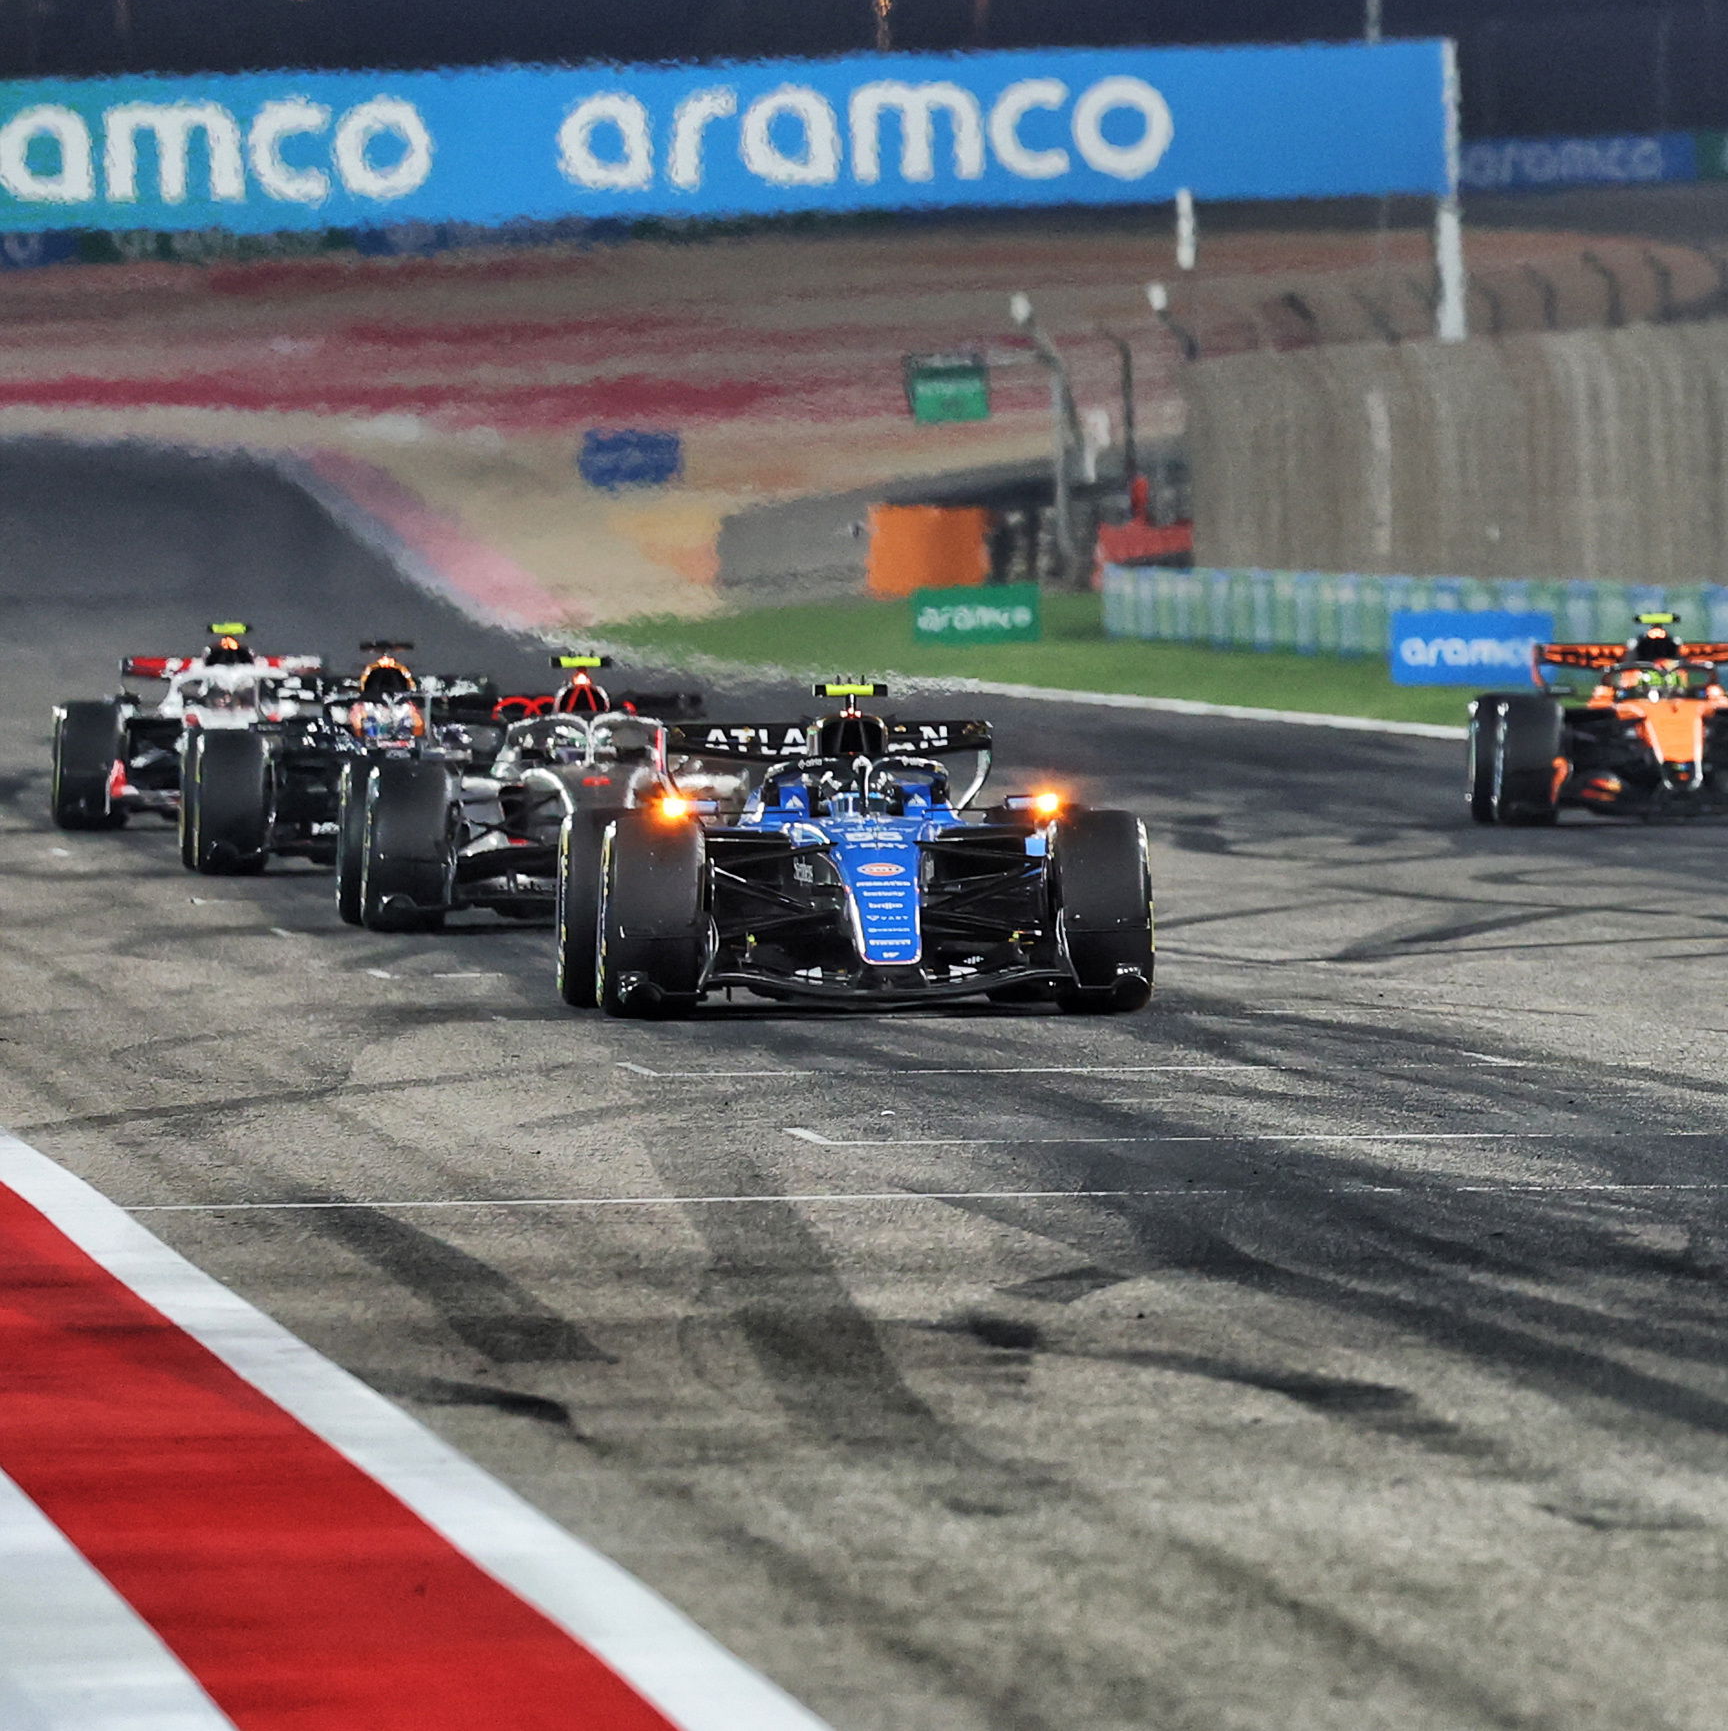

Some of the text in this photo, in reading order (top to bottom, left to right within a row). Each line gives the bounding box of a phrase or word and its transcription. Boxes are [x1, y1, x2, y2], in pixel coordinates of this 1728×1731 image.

[556, 74, 1175, 193] aramco
[1462, 138, 1663, 186] aramco
[705, 725, 949, 755] ATLAN
